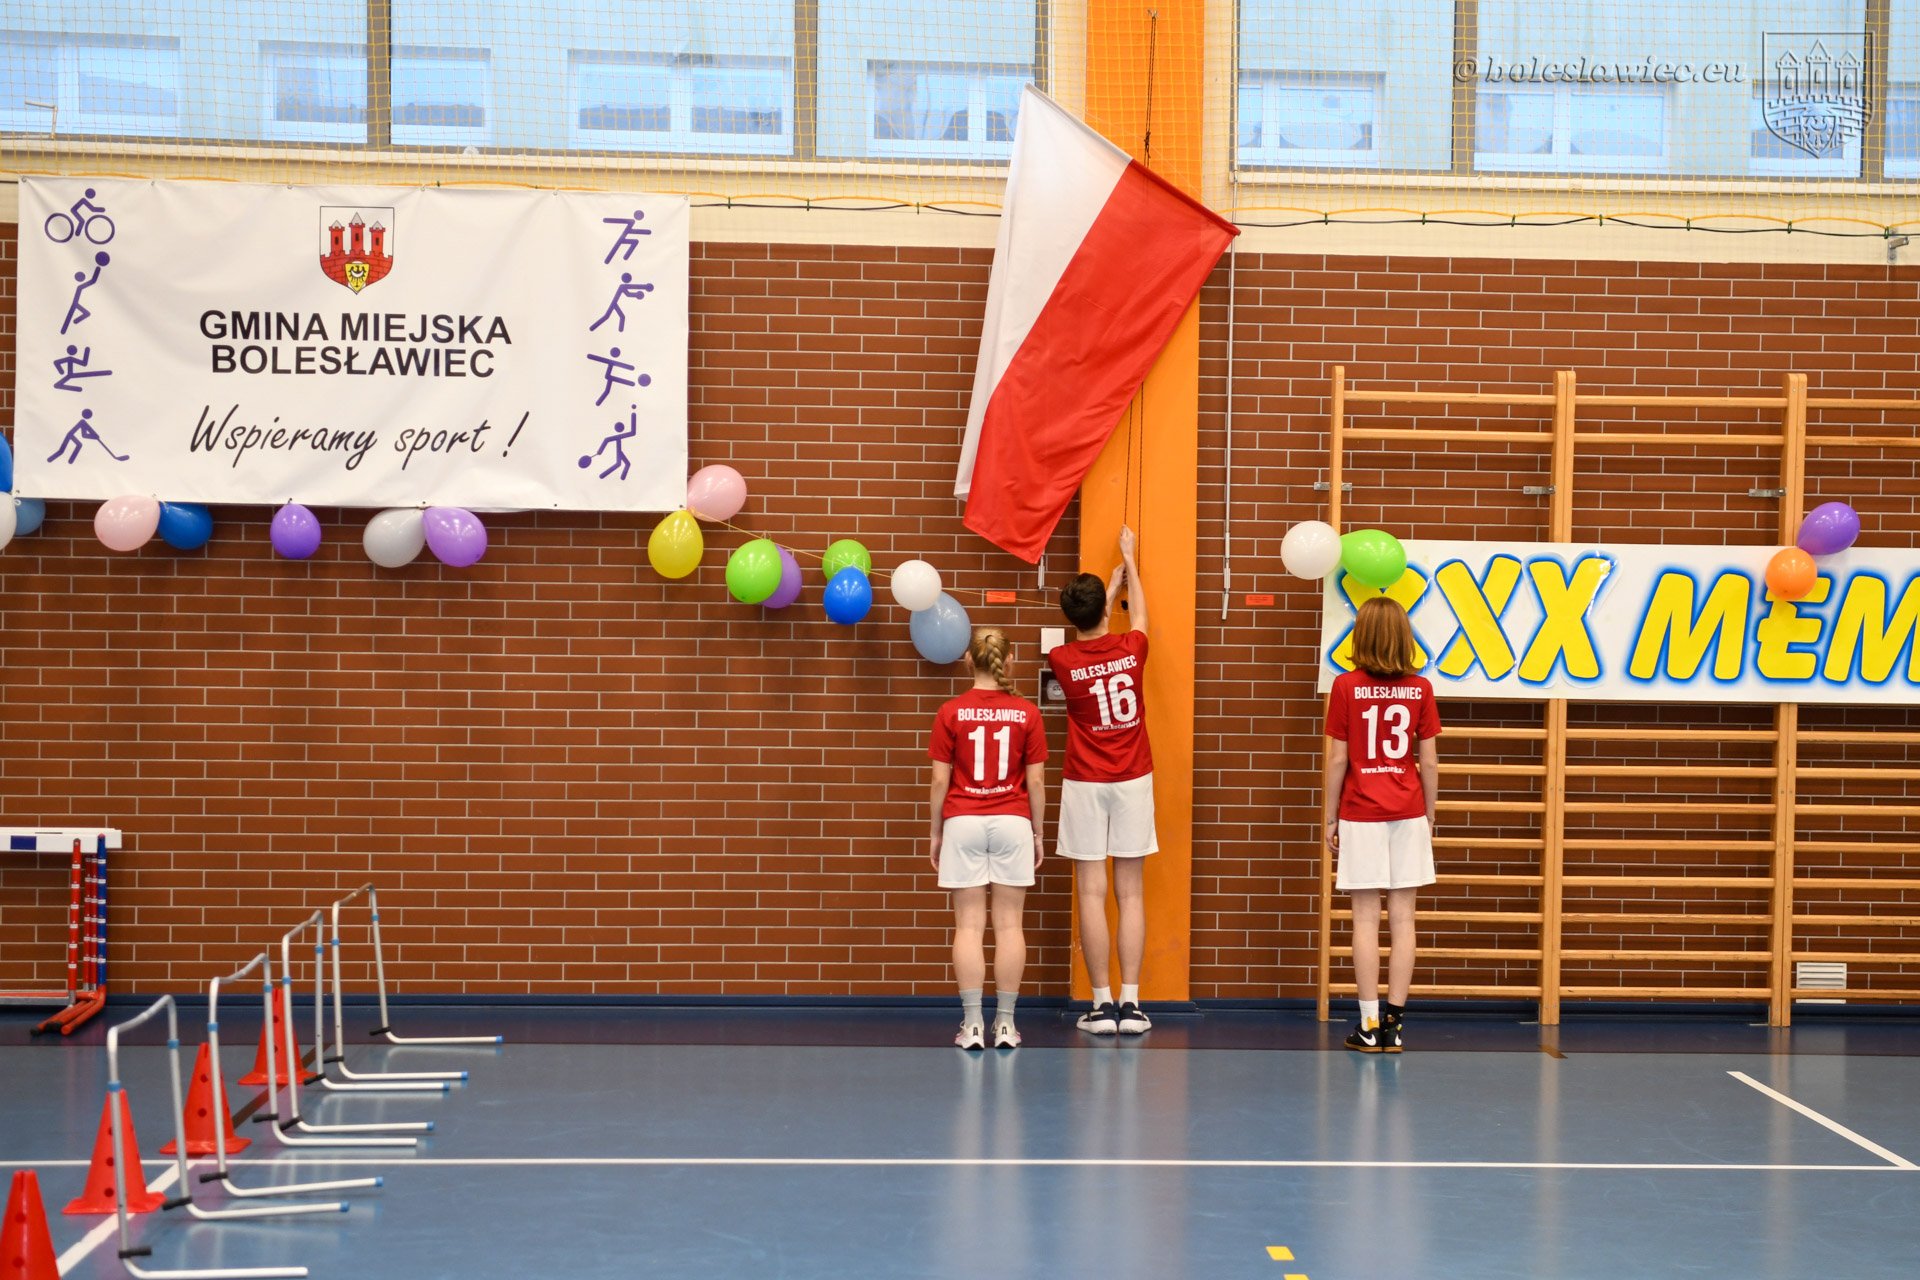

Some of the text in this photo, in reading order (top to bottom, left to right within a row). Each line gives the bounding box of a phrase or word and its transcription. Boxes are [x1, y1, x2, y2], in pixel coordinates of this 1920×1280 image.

[199, 309, 513, 345] GMINA MIEJSKA
[211, 344, 495, 378] BOLESŁAWIEC
[189, 403, 378, 471] Wspieramy
[393, 419, 492, 471] sport
[1626, 566, 1920, 686] MEM
[1070, 654, 1138, 682] BOLESŁAWIEC
[1088, 673, 1138, 726] 16
[1353, 685, 1423, 700] BOLESŁAWIEC
[957, 707, 1027, 724] BOLESŁAWIEC
[1361, 703, 1411, 760] 13
[967, 725, 1011, 781] 11
